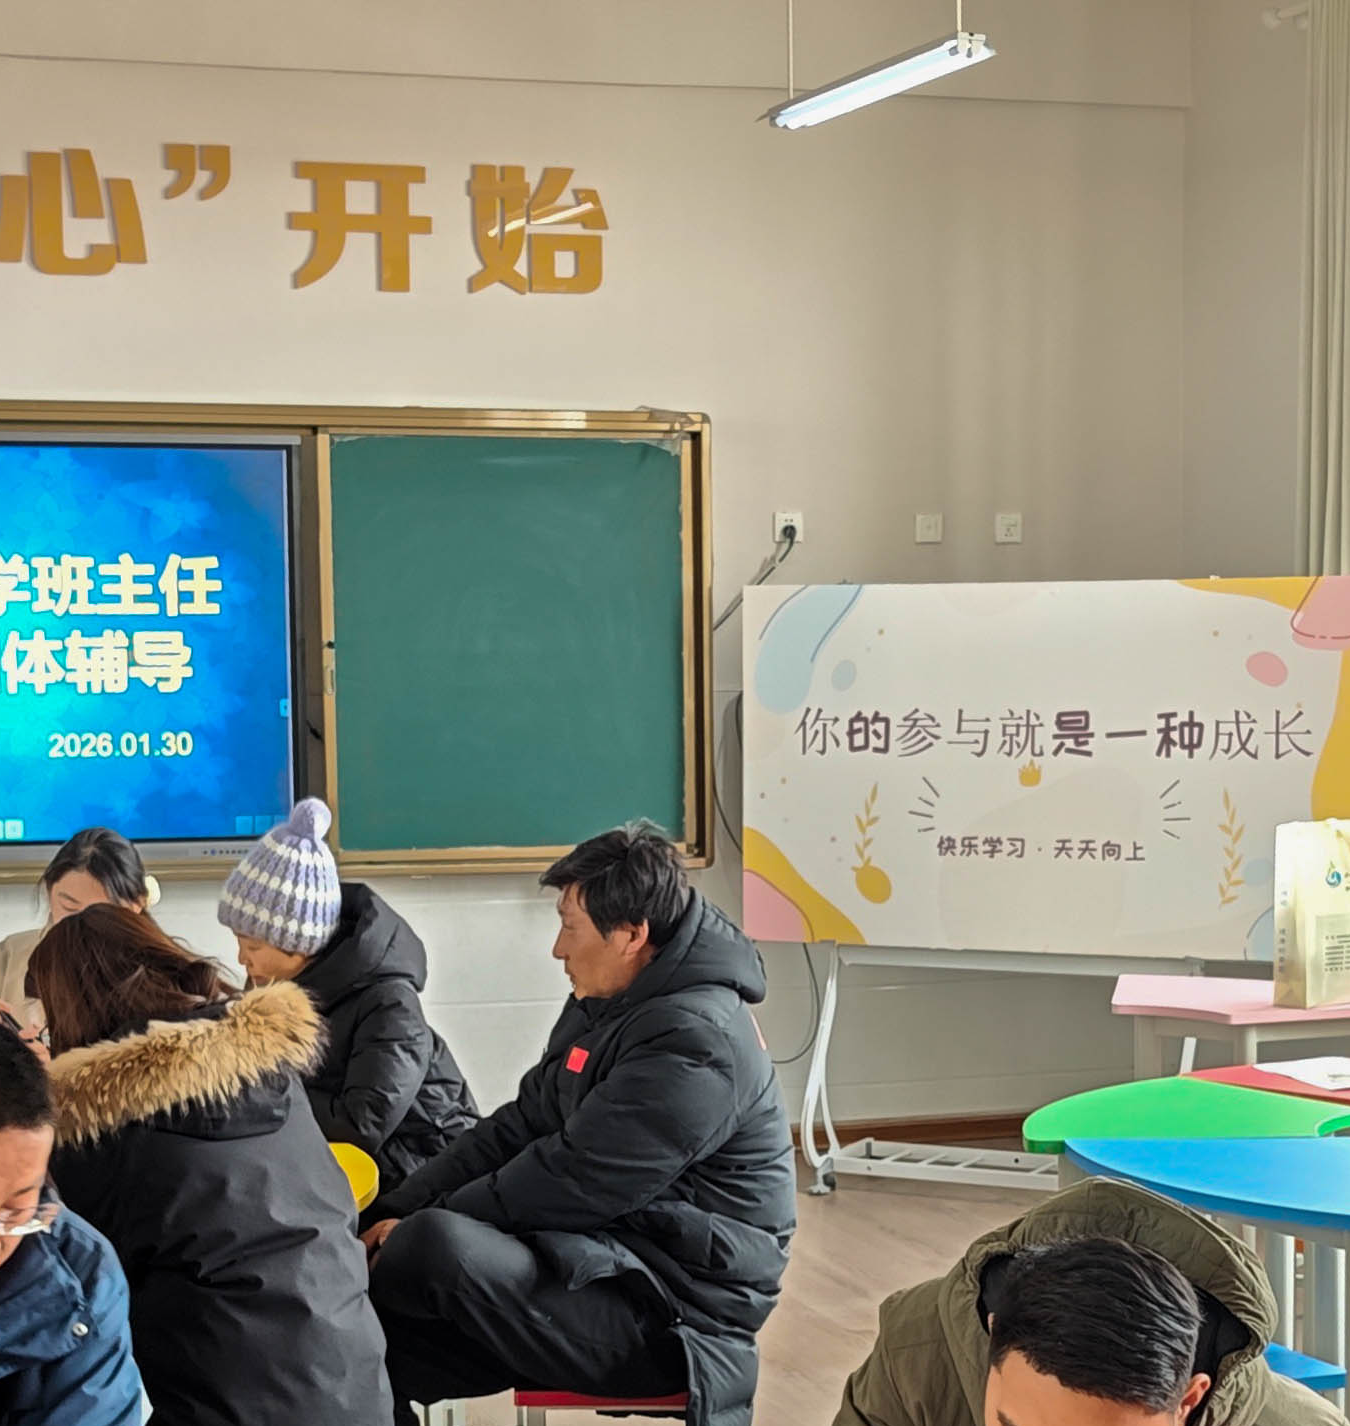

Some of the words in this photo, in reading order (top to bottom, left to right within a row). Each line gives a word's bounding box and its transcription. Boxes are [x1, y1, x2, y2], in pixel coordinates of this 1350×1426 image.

[49, 732, 194, 760] 2026.01.30
[794, 706, 1314, 761] 你的参与就是一种成长
